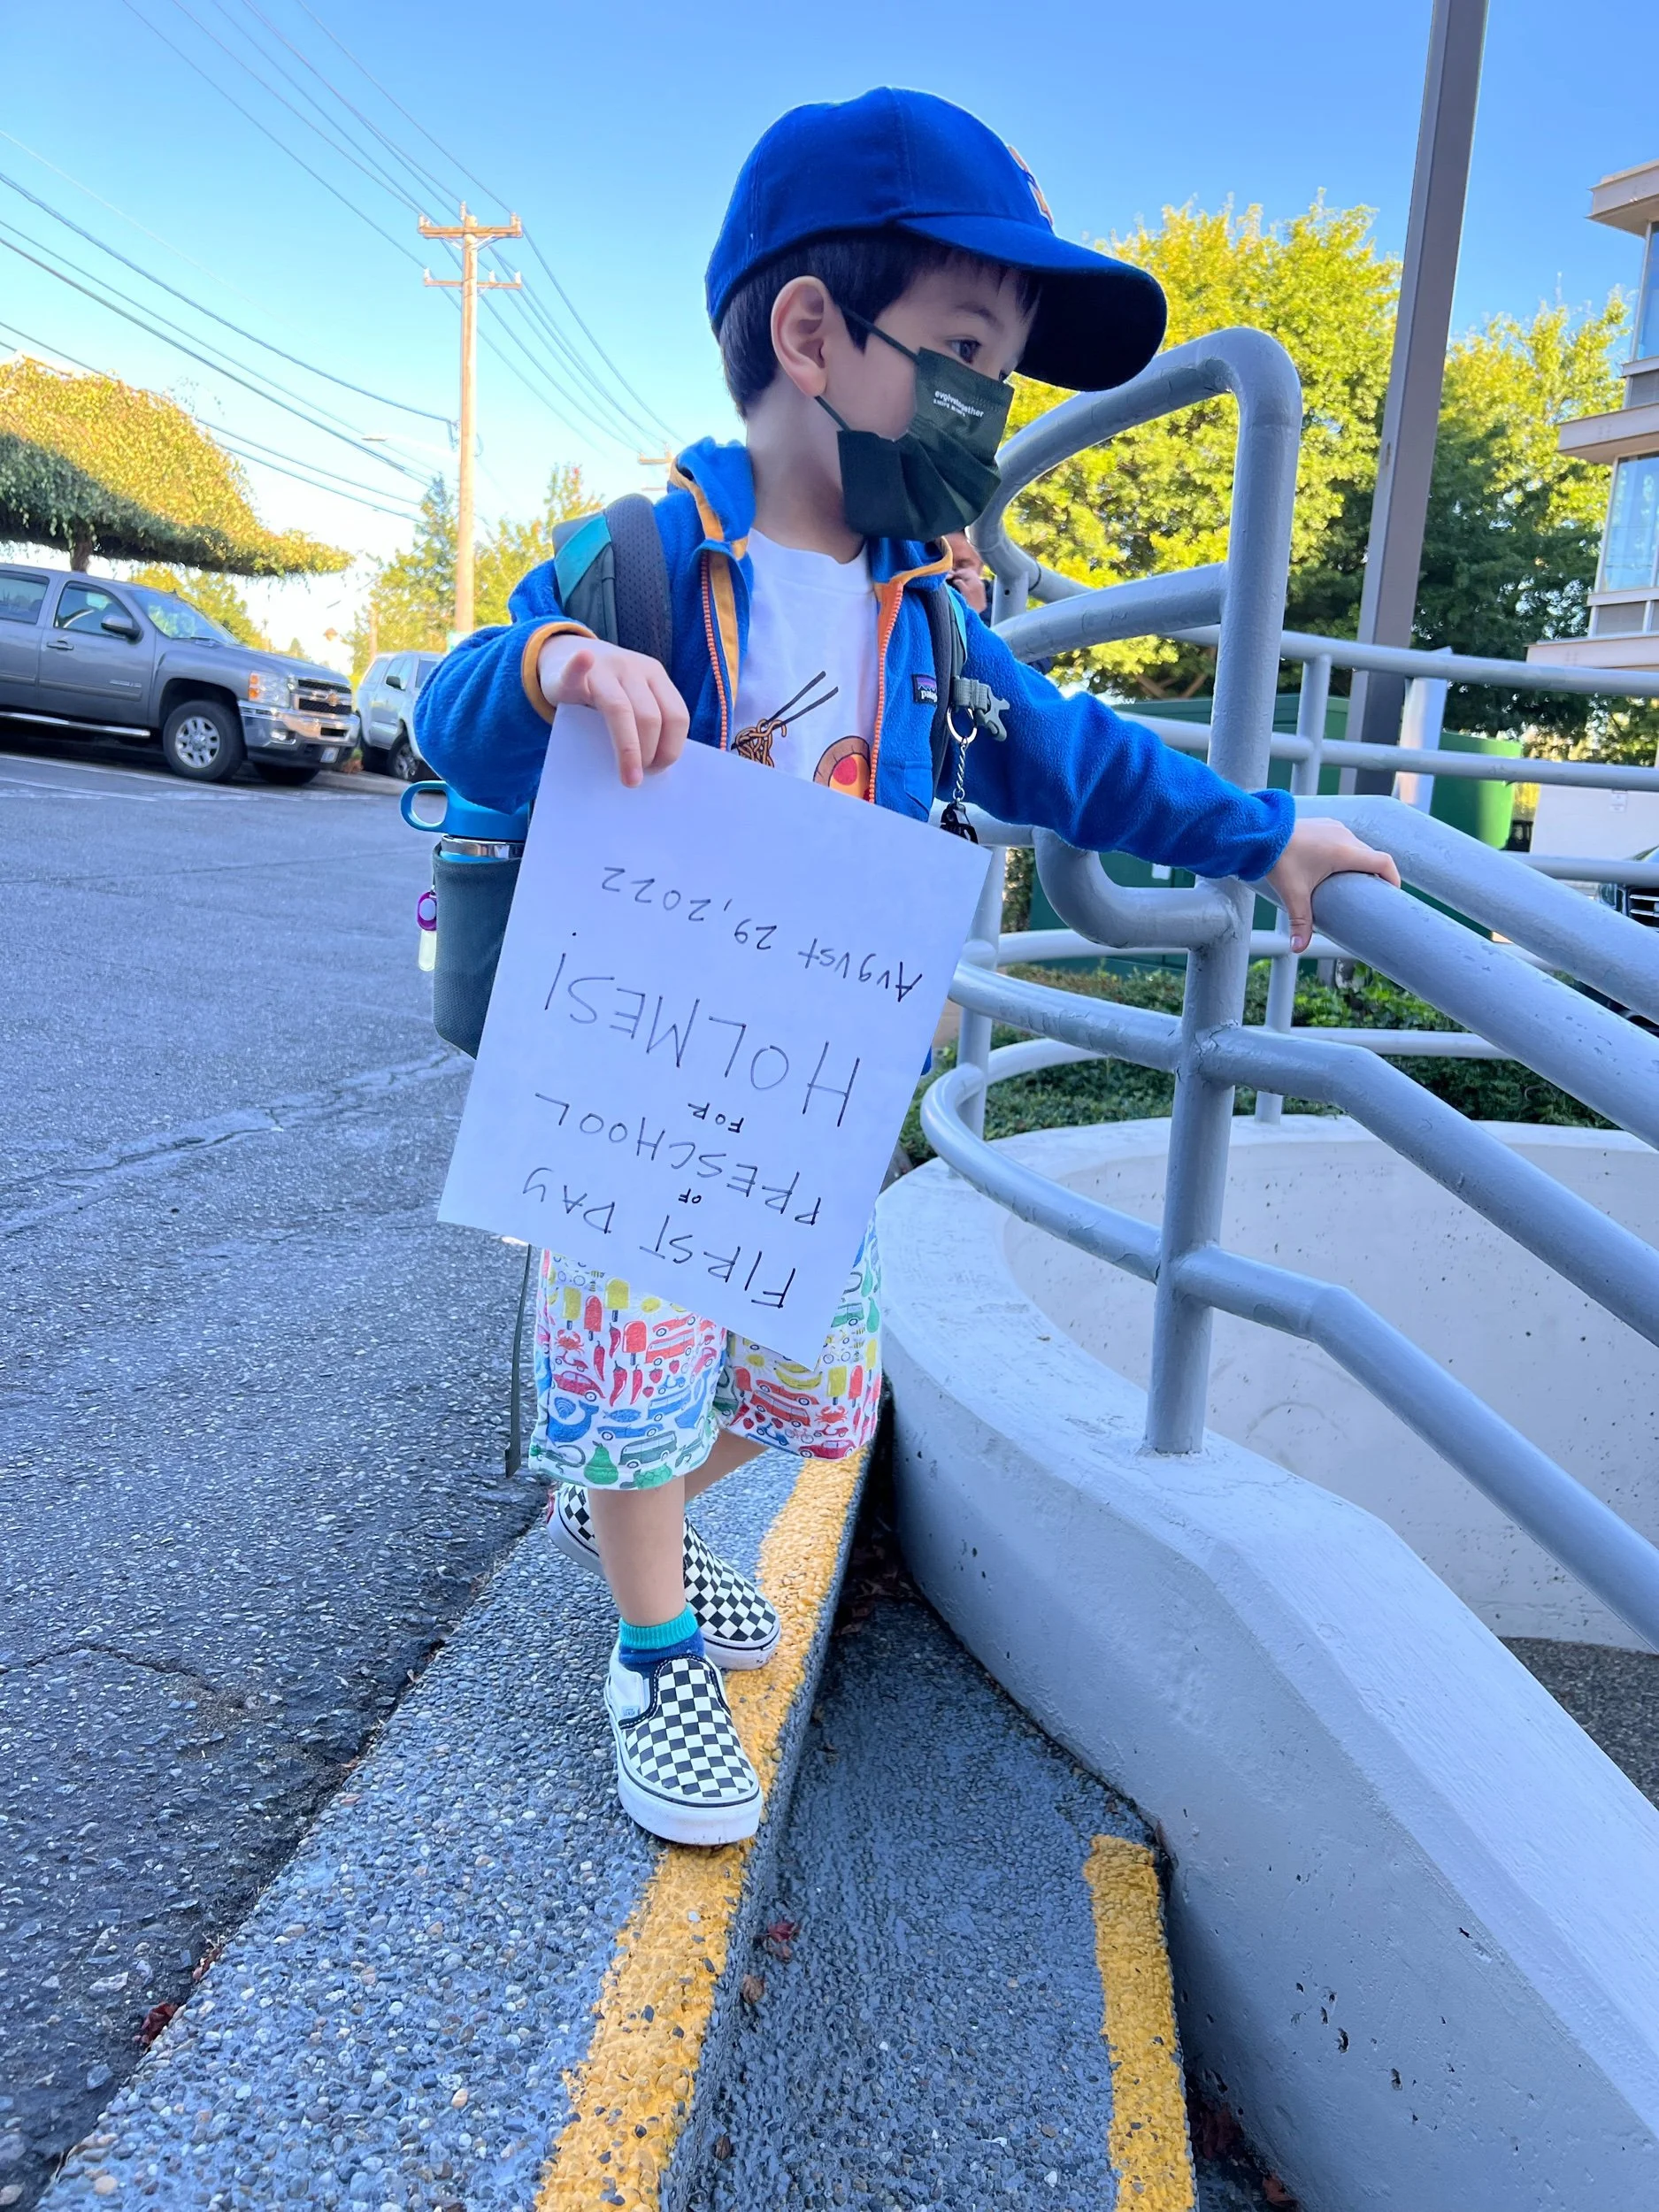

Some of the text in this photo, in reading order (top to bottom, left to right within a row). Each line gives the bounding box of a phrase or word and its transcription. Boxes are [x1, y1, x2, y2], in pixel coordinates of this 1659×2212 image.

[543, 932, 861, 1128] HOLMES!
[534, 1092, 822, 1226] PRESCHOOL
[687, 1102, 745, 1134] FOR
[522, 1167, 796, 1310] FIRST DAY
[677, 1187, 703, 1205] OF
